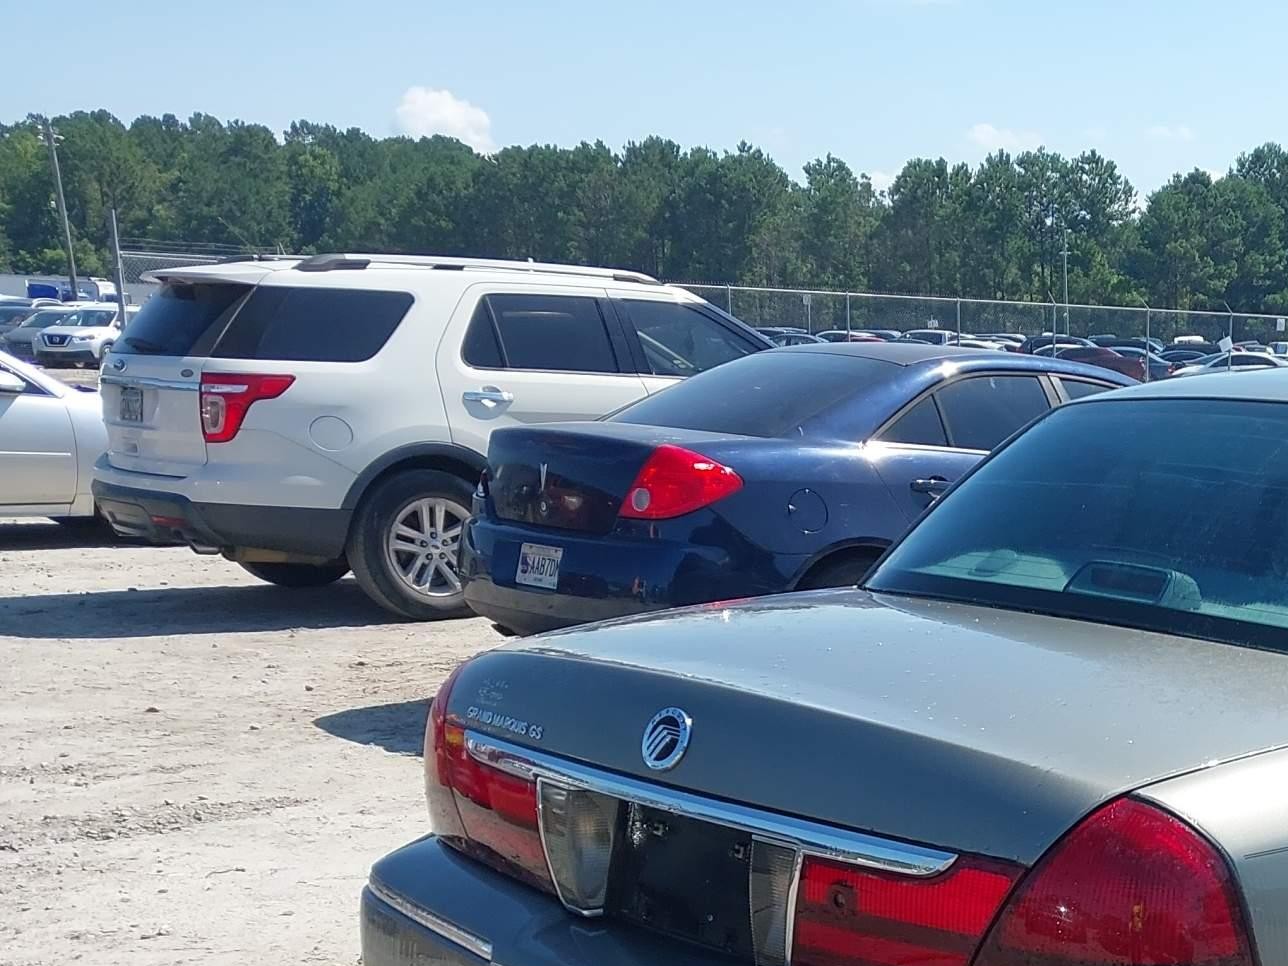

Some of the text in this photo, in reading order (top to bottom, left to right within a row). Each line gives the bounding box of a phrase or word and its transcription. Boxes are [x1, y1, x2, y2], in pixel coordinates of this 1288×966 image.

[466, 706, 543, 740] GRAND MARQUIS GS
